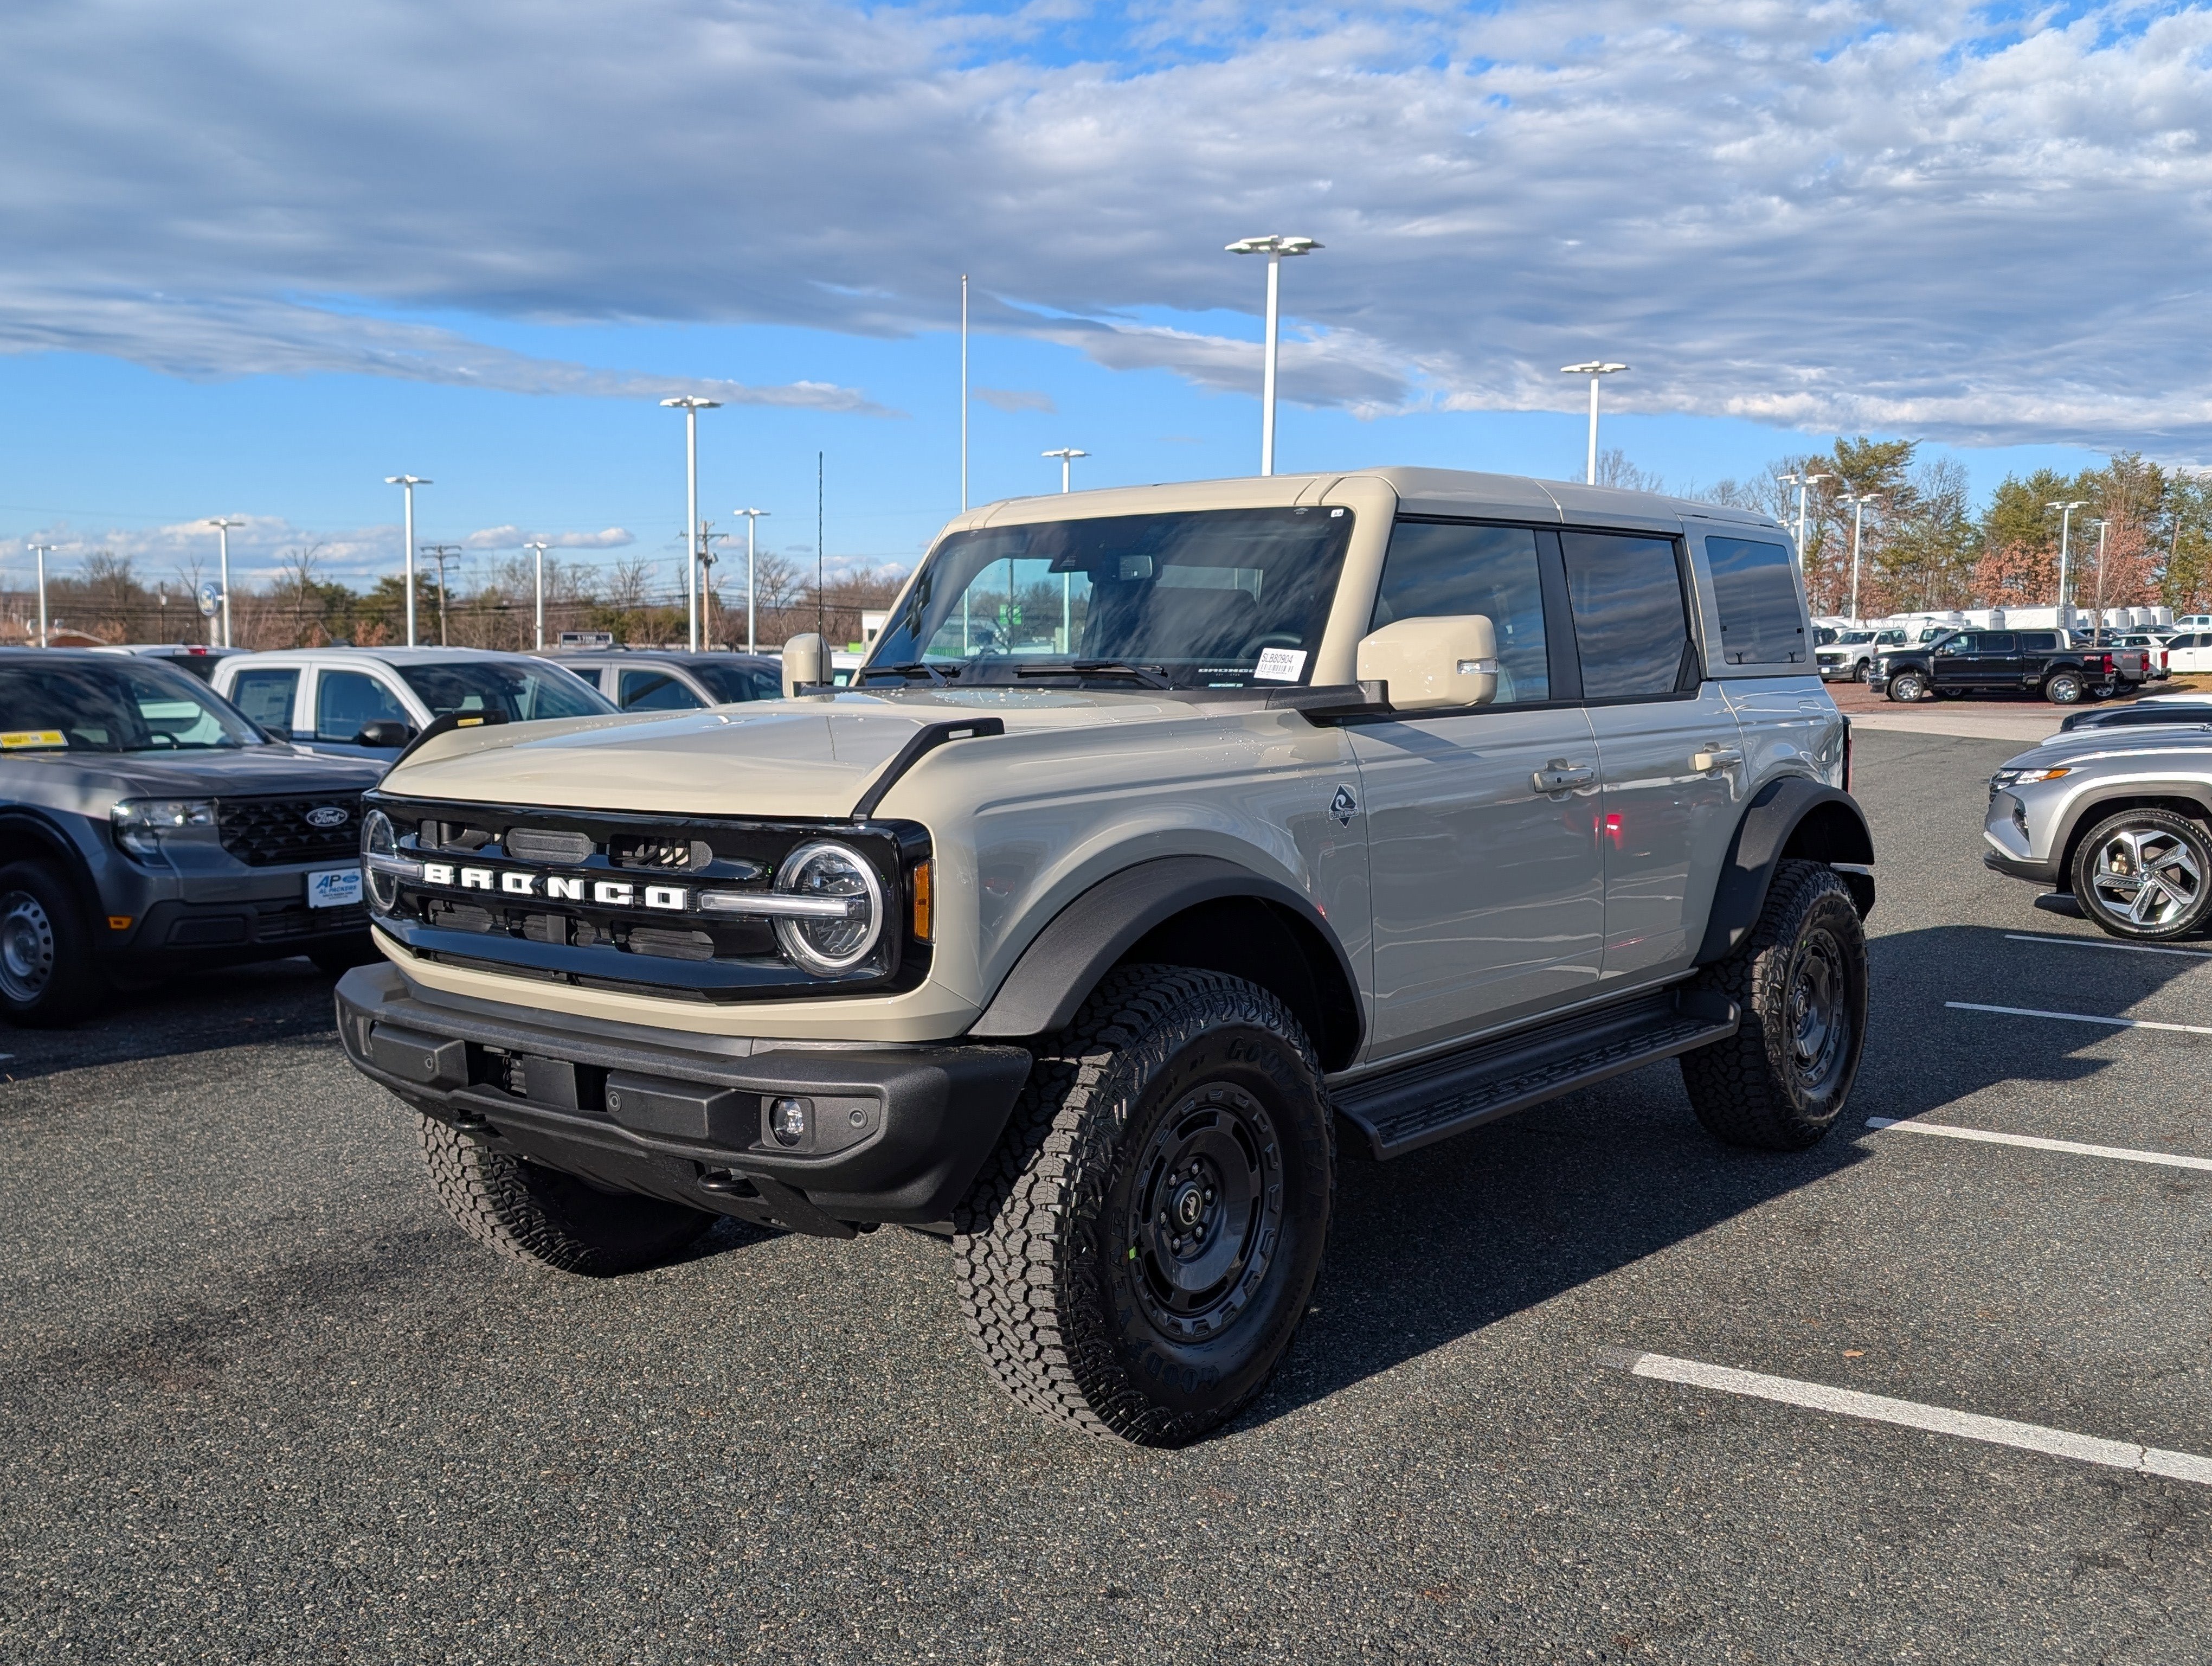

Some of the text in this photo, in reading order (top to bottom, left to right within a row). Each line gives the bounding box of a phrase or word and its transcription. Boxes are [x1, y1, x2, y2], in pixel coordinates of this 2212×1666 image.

[1262, 653, 1294, 664] SLB80904
[316, 874, 341, 889] AP
[424, 863, 688, 910] BRONCO
